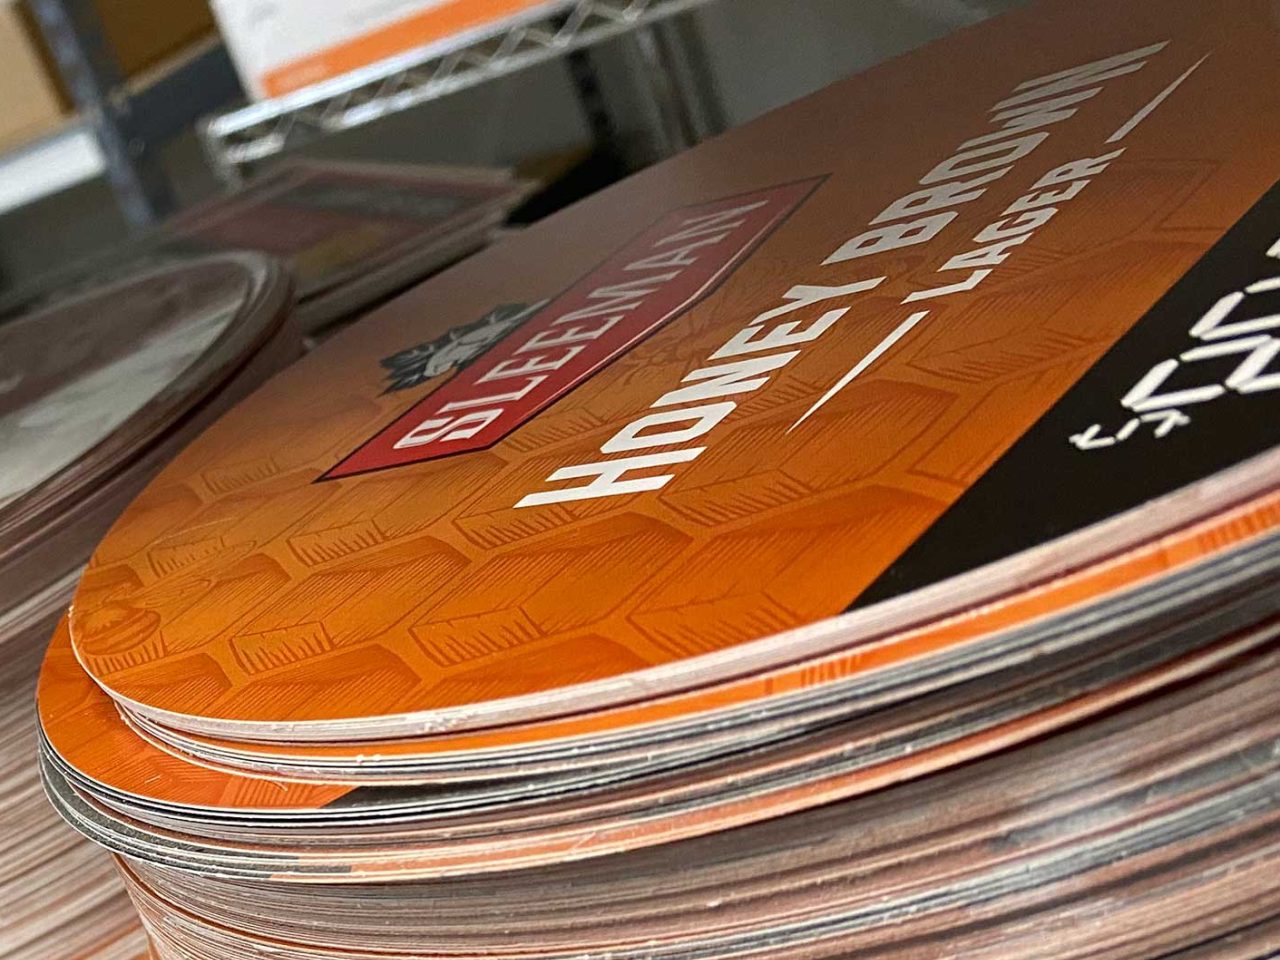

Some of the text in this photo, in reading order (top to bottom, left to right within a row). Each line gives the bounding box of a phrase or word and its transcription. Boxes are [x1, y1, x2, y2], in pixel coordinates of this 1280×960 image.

[393, 200, 768, 450] SLEEMAN
[513, 40, 1170, 508] HONEY BROWN
[900, 147, 1126, 304] LAGER
